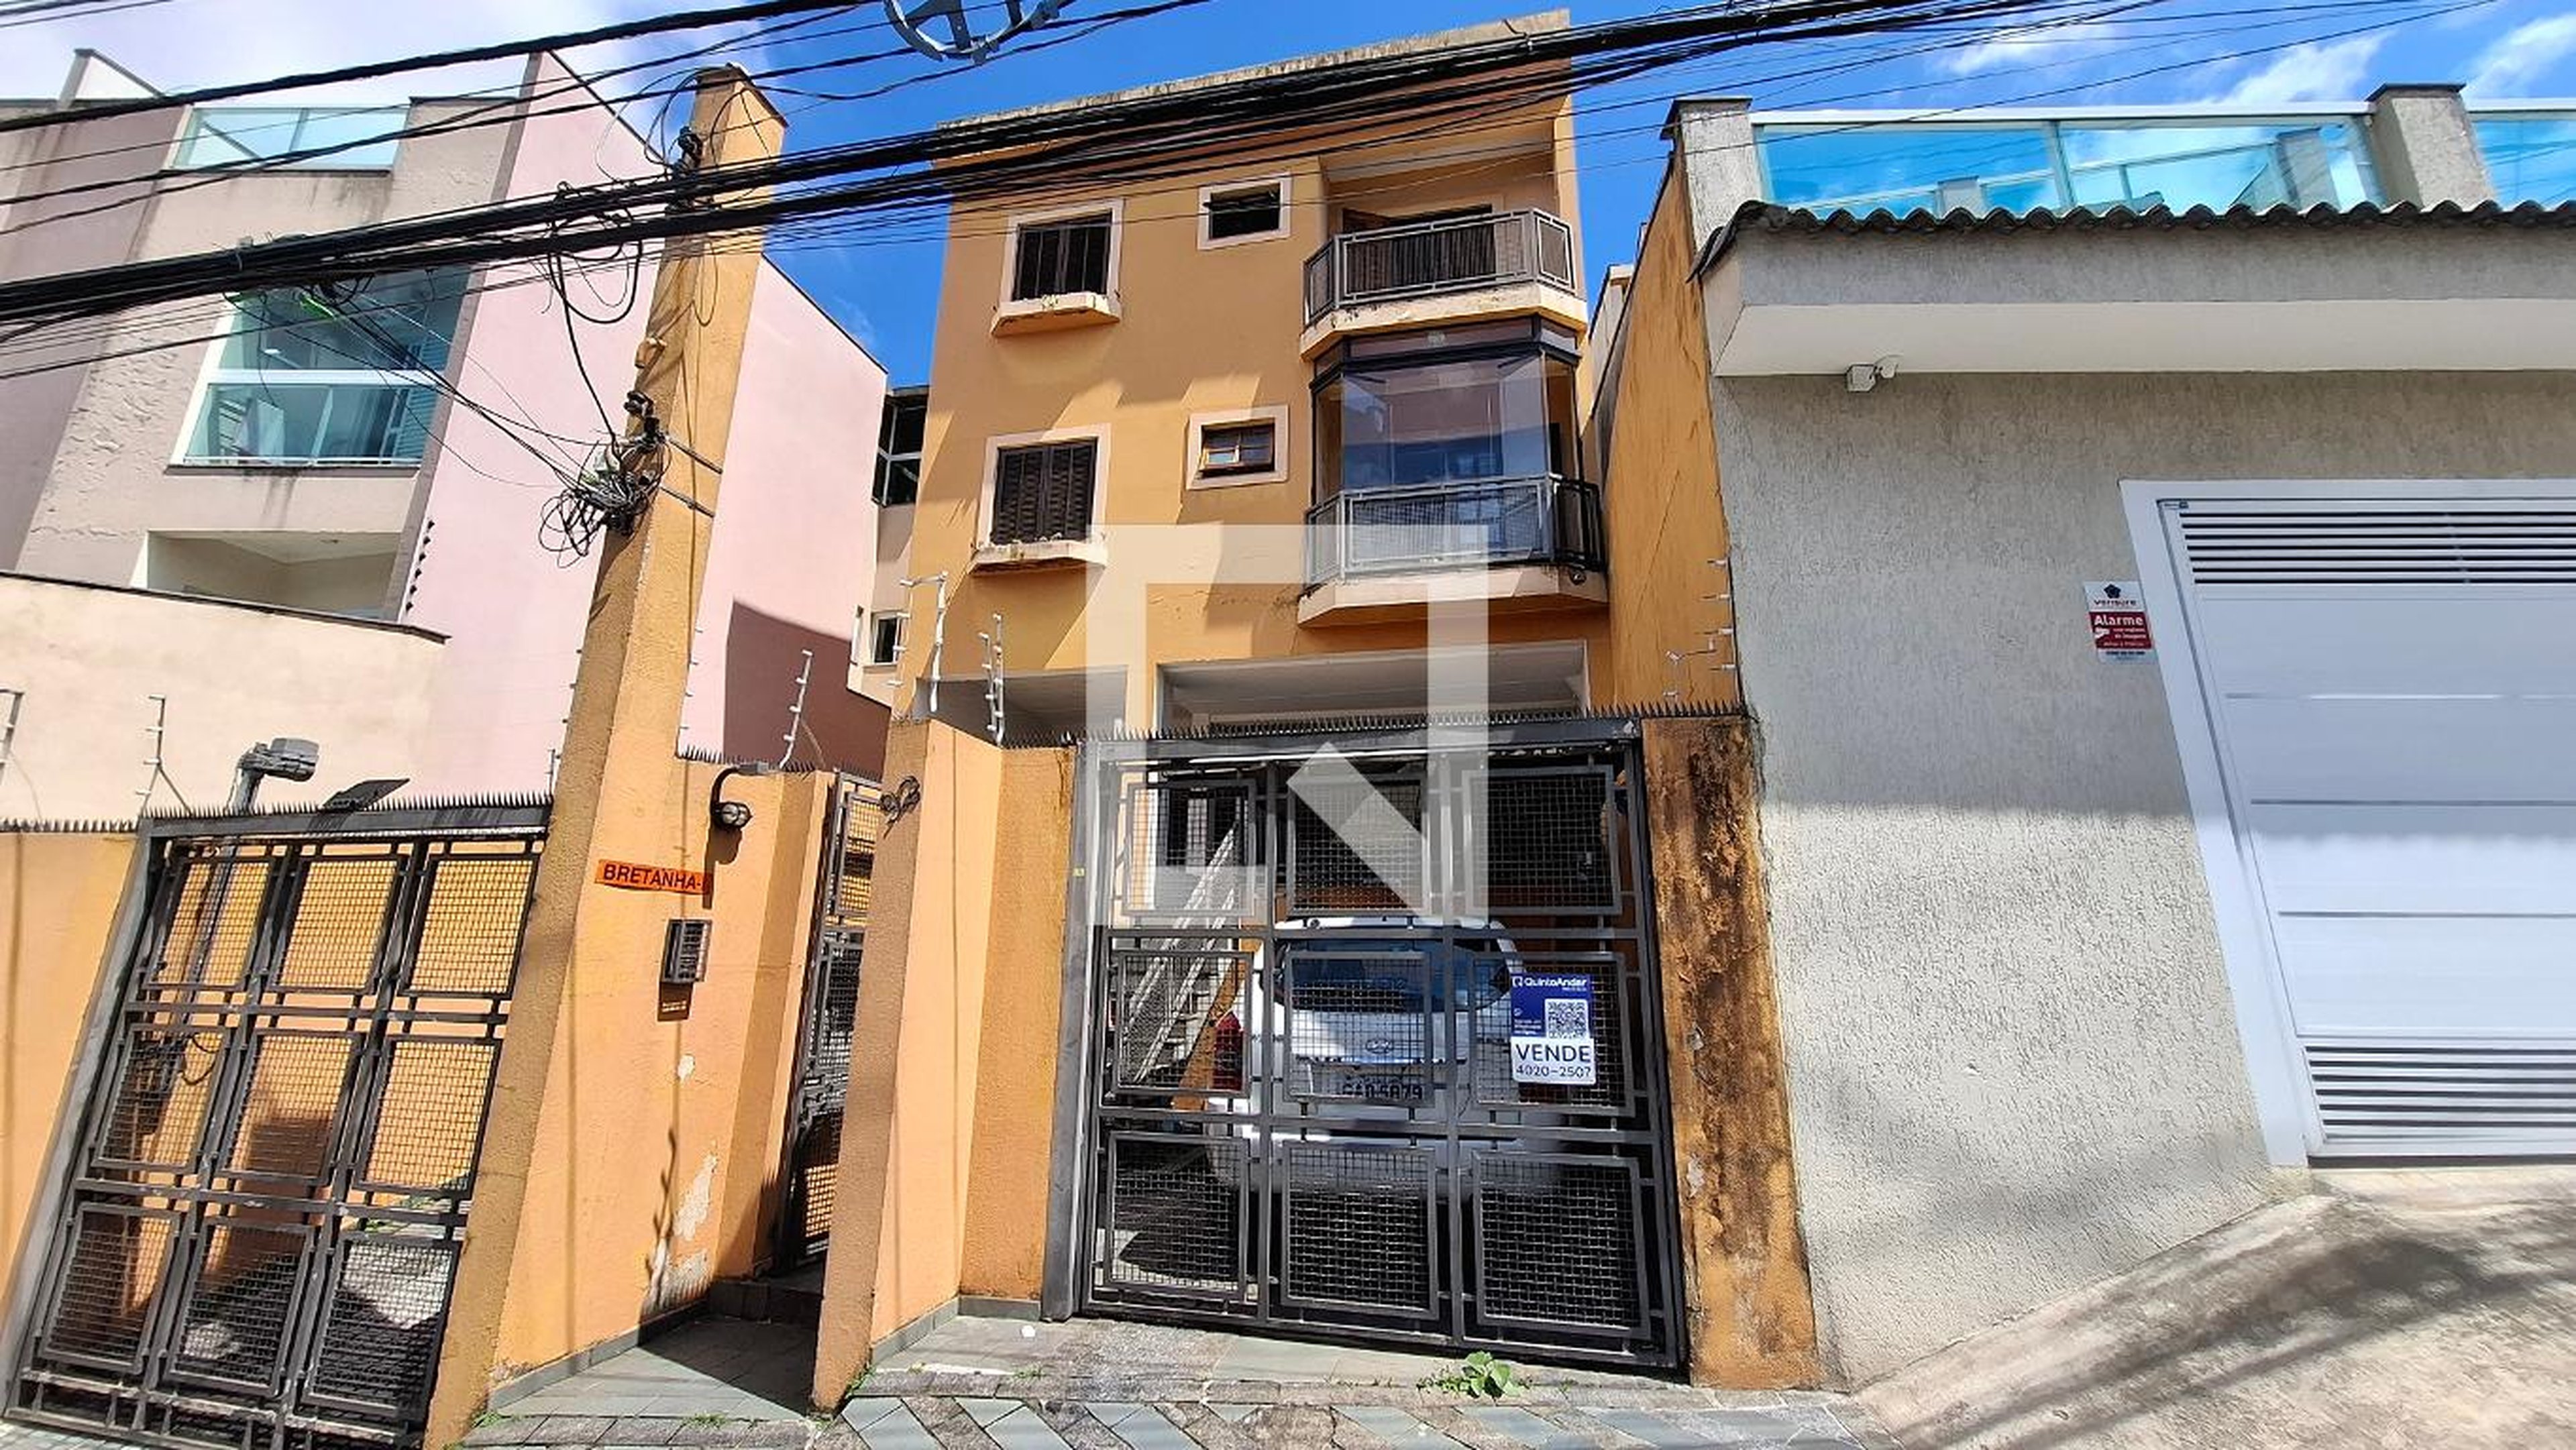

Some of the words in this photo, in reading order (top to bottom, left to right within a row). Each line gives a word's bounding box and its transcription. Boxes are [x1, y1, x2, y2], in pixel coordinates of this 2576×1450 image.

[2094, 614, 2144, 626] Alarme
[1523, 977, 1587, 987] QuintoAndar
[1515, 1044, 1591, 1062] VENDE
[1516, 1064, 1591, 1078] 4020-2507
